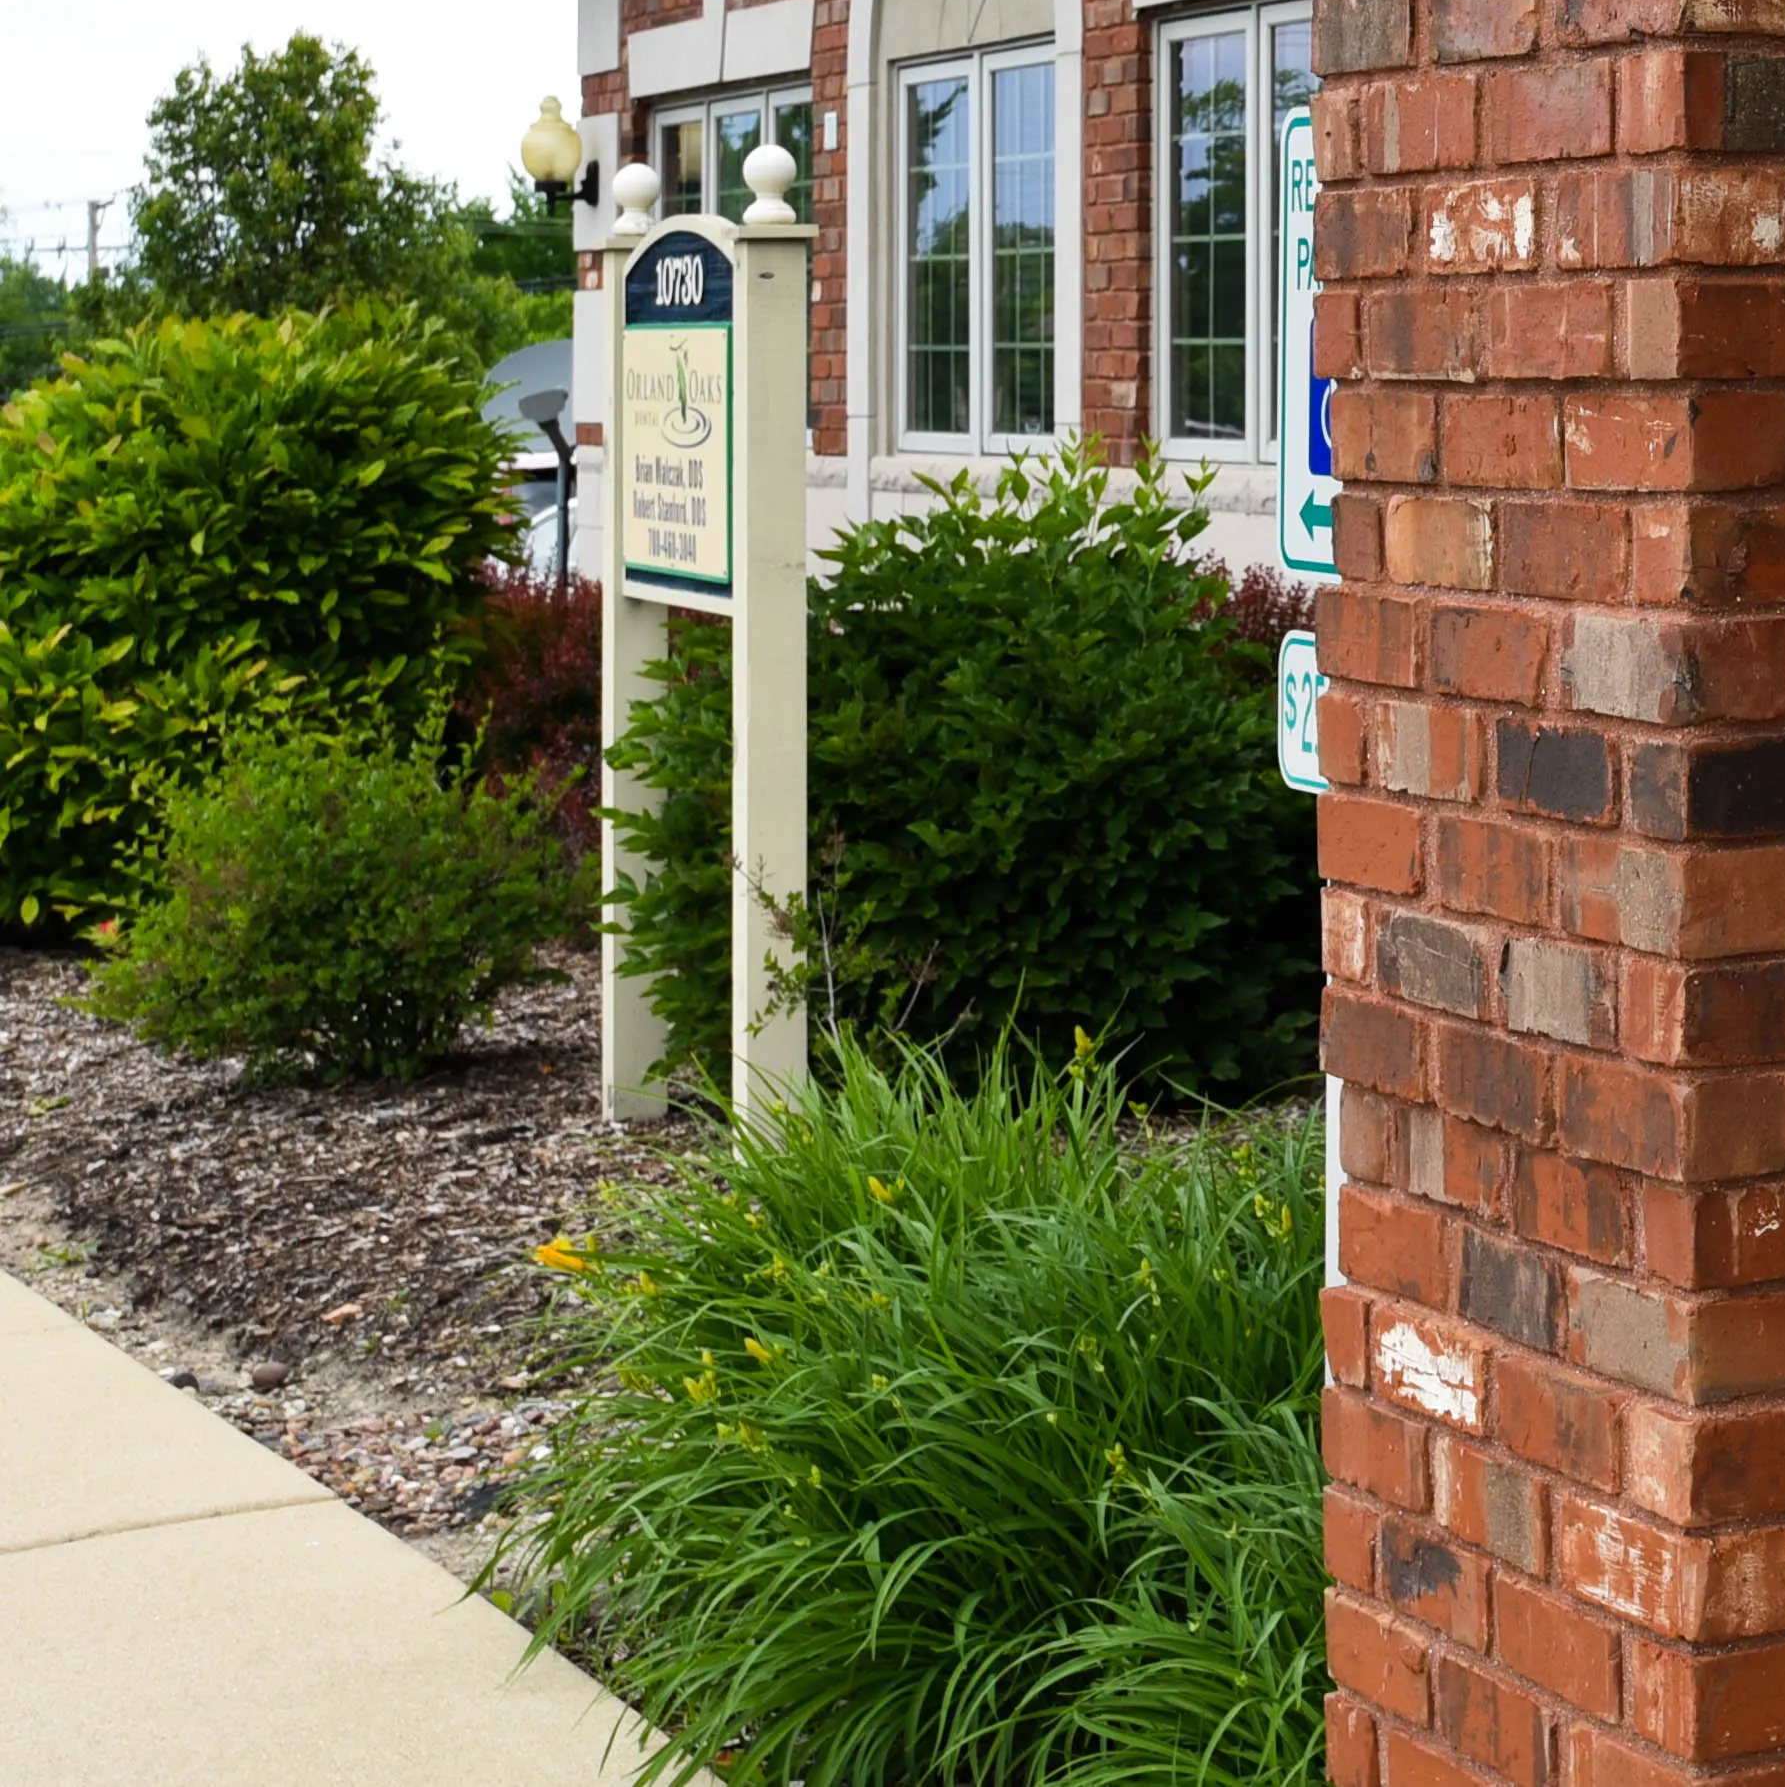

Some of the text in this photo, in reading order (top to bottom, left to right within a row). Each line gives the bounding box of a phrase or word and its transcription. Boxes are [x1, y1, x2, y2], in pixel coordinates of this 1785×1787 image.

[655, 254, 704, 306] 10730
[626, 367, 722, 404] ORLAND OAKS
[688, 457, 704, 490] DDS
[691, 495, 706, 528] DDS
